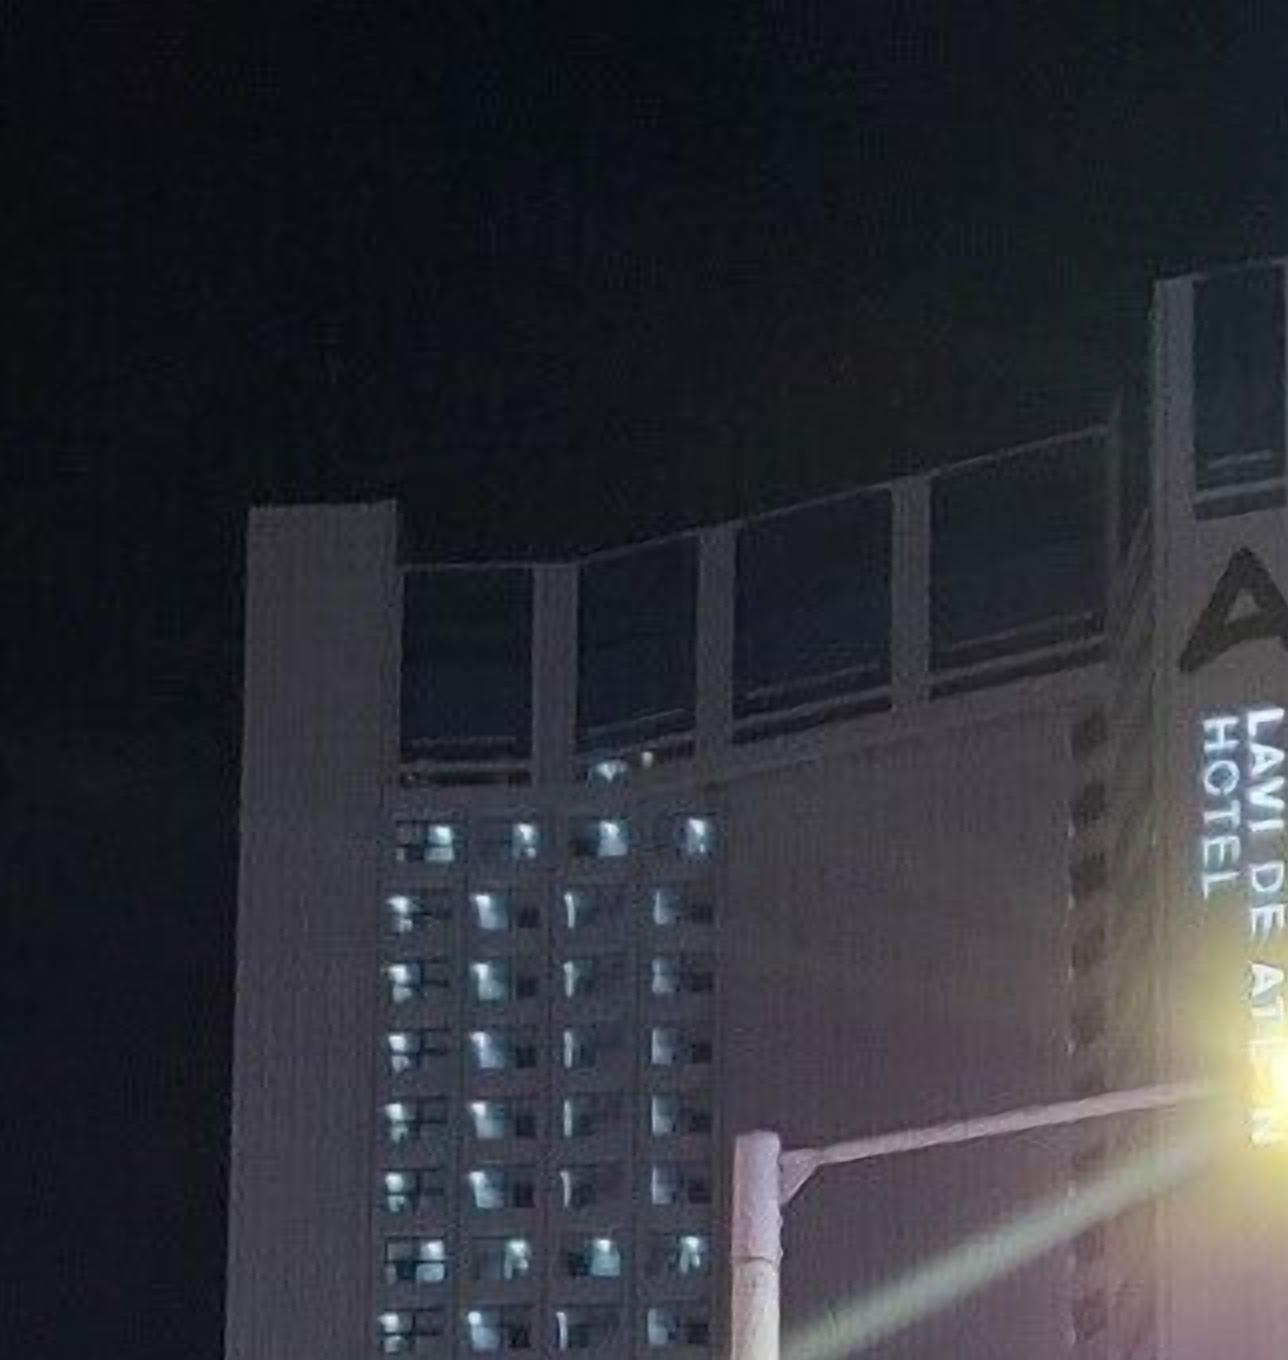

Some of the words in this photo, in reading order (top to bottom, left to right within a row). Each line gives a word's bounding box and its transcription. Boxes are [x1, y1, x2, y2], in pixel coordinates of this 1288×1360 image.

[1201, 715, 1240, 901] HOTEL
[1247, 706, 1286, 834] LAVI
[1248, 860, 1286, 940] DE
